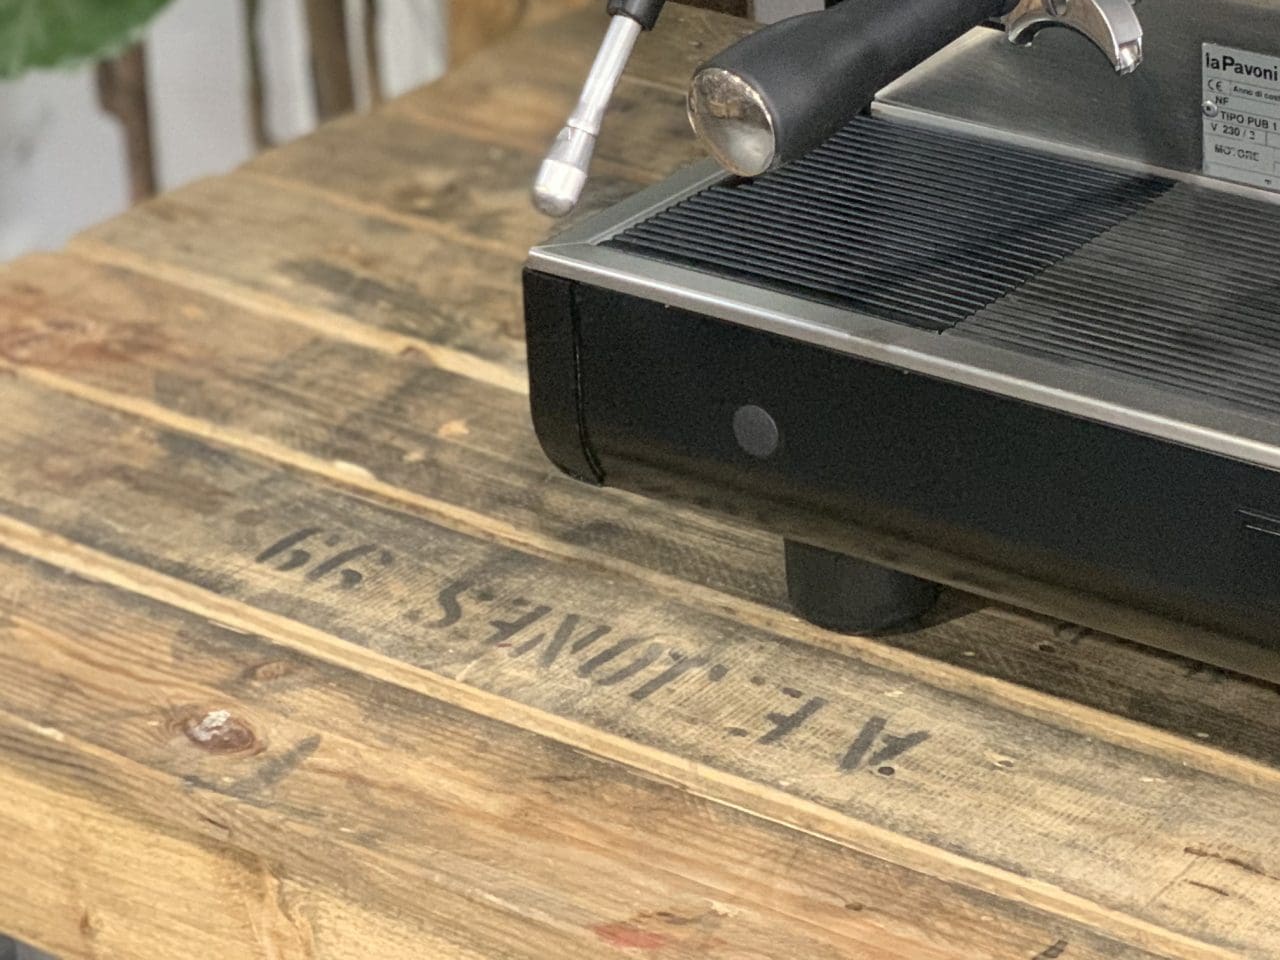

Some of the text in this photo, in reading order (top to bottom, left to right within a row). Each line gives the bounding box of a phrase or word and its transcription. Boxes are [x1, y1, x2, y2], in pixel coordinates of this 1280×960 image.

[1221, 111, 1244, 124] TIPO
[1247, 116, 1269, 129] PUB
[1211, 122, 1218, 132] V
[1223, 125, 1240, 136] 230
